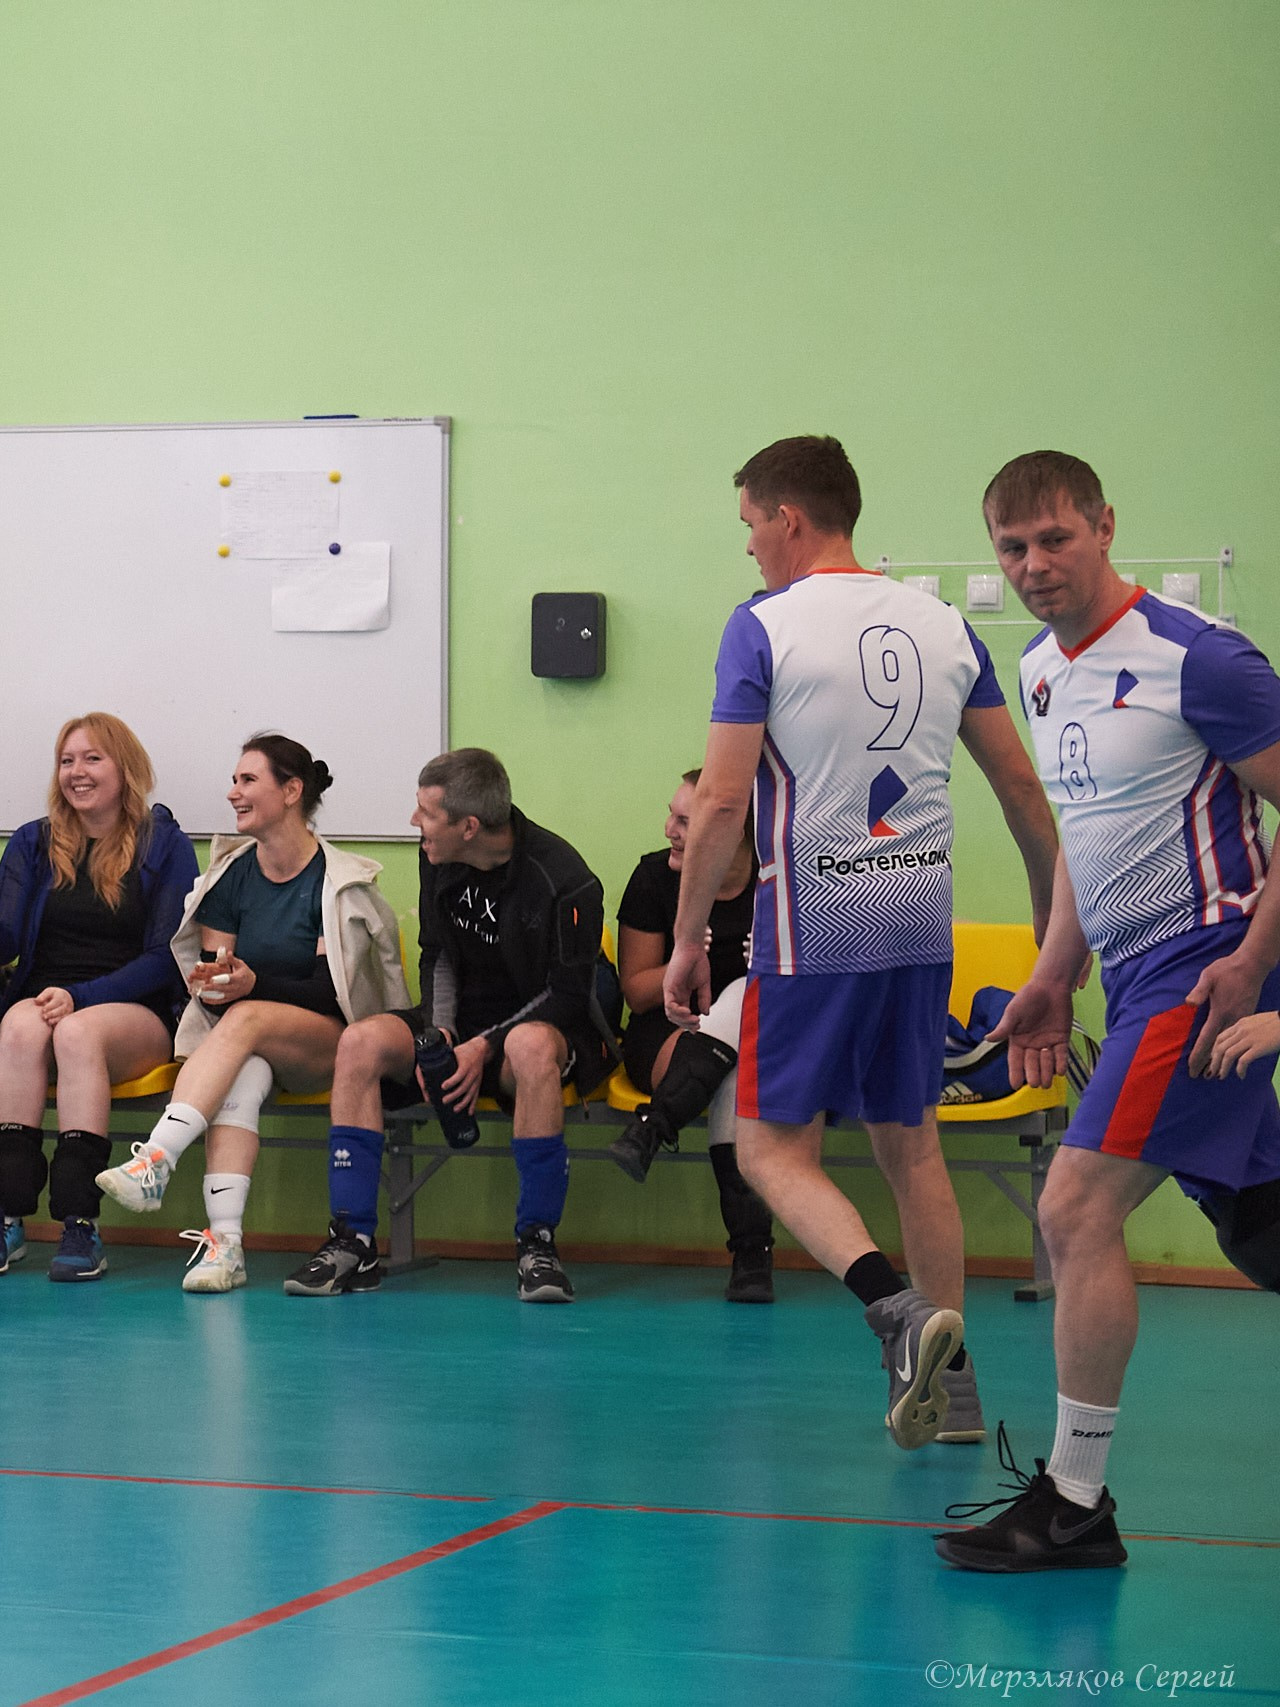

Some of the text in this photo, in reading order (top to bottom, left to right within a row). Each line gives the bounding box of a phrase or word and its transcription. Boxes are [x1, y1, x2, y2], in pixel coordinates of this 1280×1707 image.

[859, 625, 923, 751] 9
[1059, 722, 1098, 801] 8
[816, 850, 951, 877] Ростелеком
